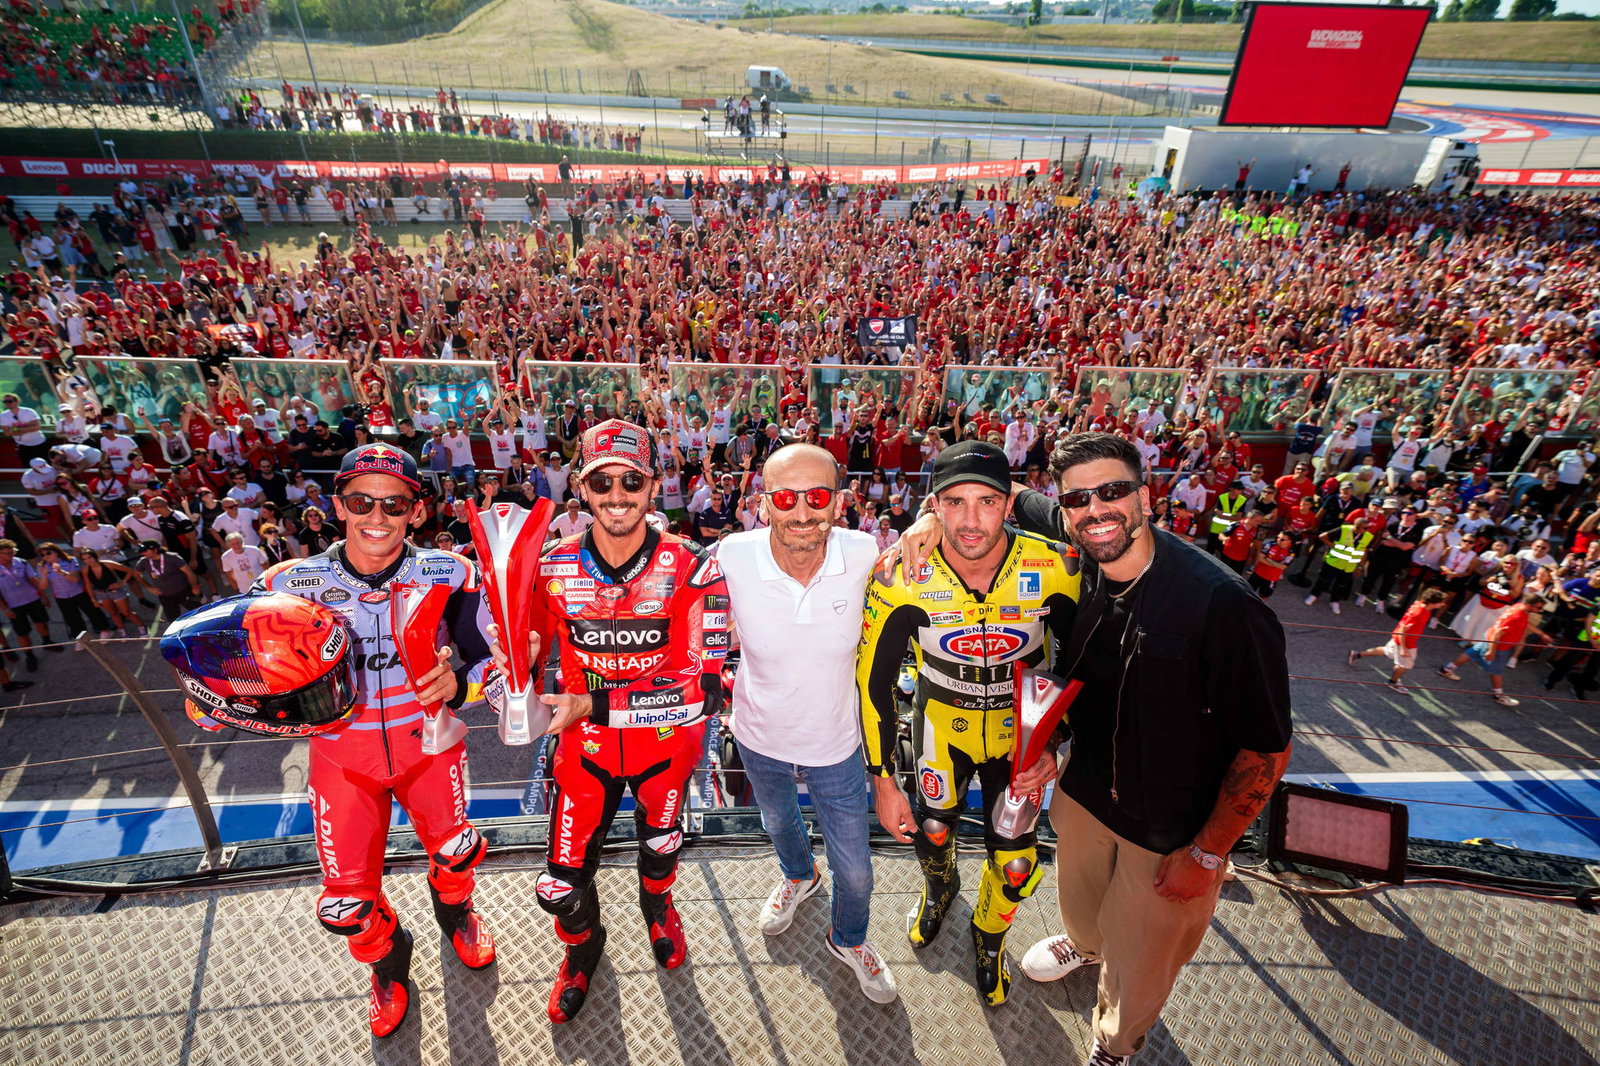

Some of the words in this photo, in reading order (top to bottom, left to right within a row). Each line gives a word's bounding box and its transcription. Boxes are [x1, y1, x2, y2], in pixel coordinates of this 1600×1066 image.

[82, 163, 138, 174] DUCATI
[331, 166, 381, 177] DUCATI
[945, 165, 980, 177] DUCATI
[613, 436, 636, 444] Lenovo
[355, 459, 379, 470] Red
[380, 459, 404, 474] Bull
[622, 557, 648, 583] Lenovo
[1022, 558, 1054, 567] PIRELLI
[421, 567, 454, 576] Unibat
[591, 566, 605, 582] TIM
[291, 578, 320, 588] SHOEI
[573, 579, 593, 587] riello
[920, 591, 952, 600] NOLAN
[571, 625, 662, 646] Lenovo
[965, 625, 1002, 635] SNACK
[325, 627, 344, 657] SHOEI
[957, 638, 1011, 653] PATA
[593, 654, 664, 671] NetApp
[947, 678, 984, 693] URBAN
[189, 682, 223, 707] SHOEI
[632, 694, 680, 706] Lenovo
[236, 704, 254, 713] SHOEI
[211, 708, 253, 728] Red
[251, 721, 292, 734] Bull
[629, 708, 689, 725] UnipolSai
[449, 764, 463, 817] DAIKO
[660, 789, 678, 828] DAIKO
[320, 818, 341, 878] DAIKO
